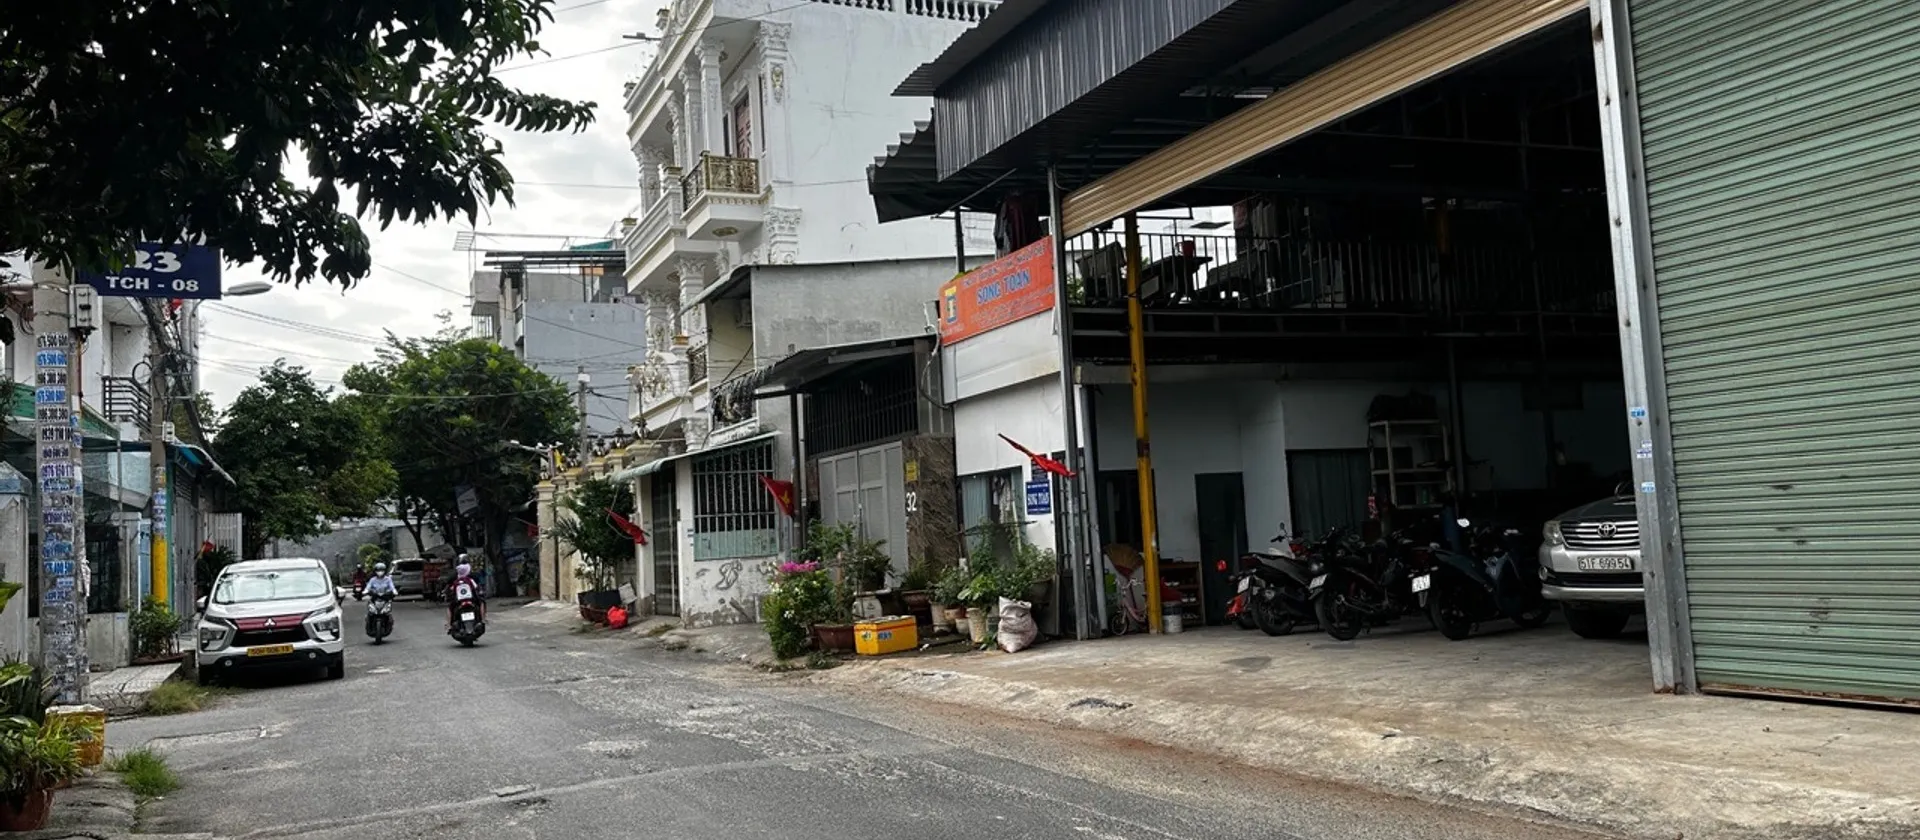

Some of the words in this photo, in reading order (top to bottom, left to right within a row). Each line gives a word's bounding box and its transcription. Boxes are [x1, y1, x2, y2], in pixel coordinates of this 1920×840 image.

[105, 275, 150, 290] TCH
[171, 278, 200, 292] 08
[976, 281, 1001, 305] SONG
[906, 491, 917, 512] 32
